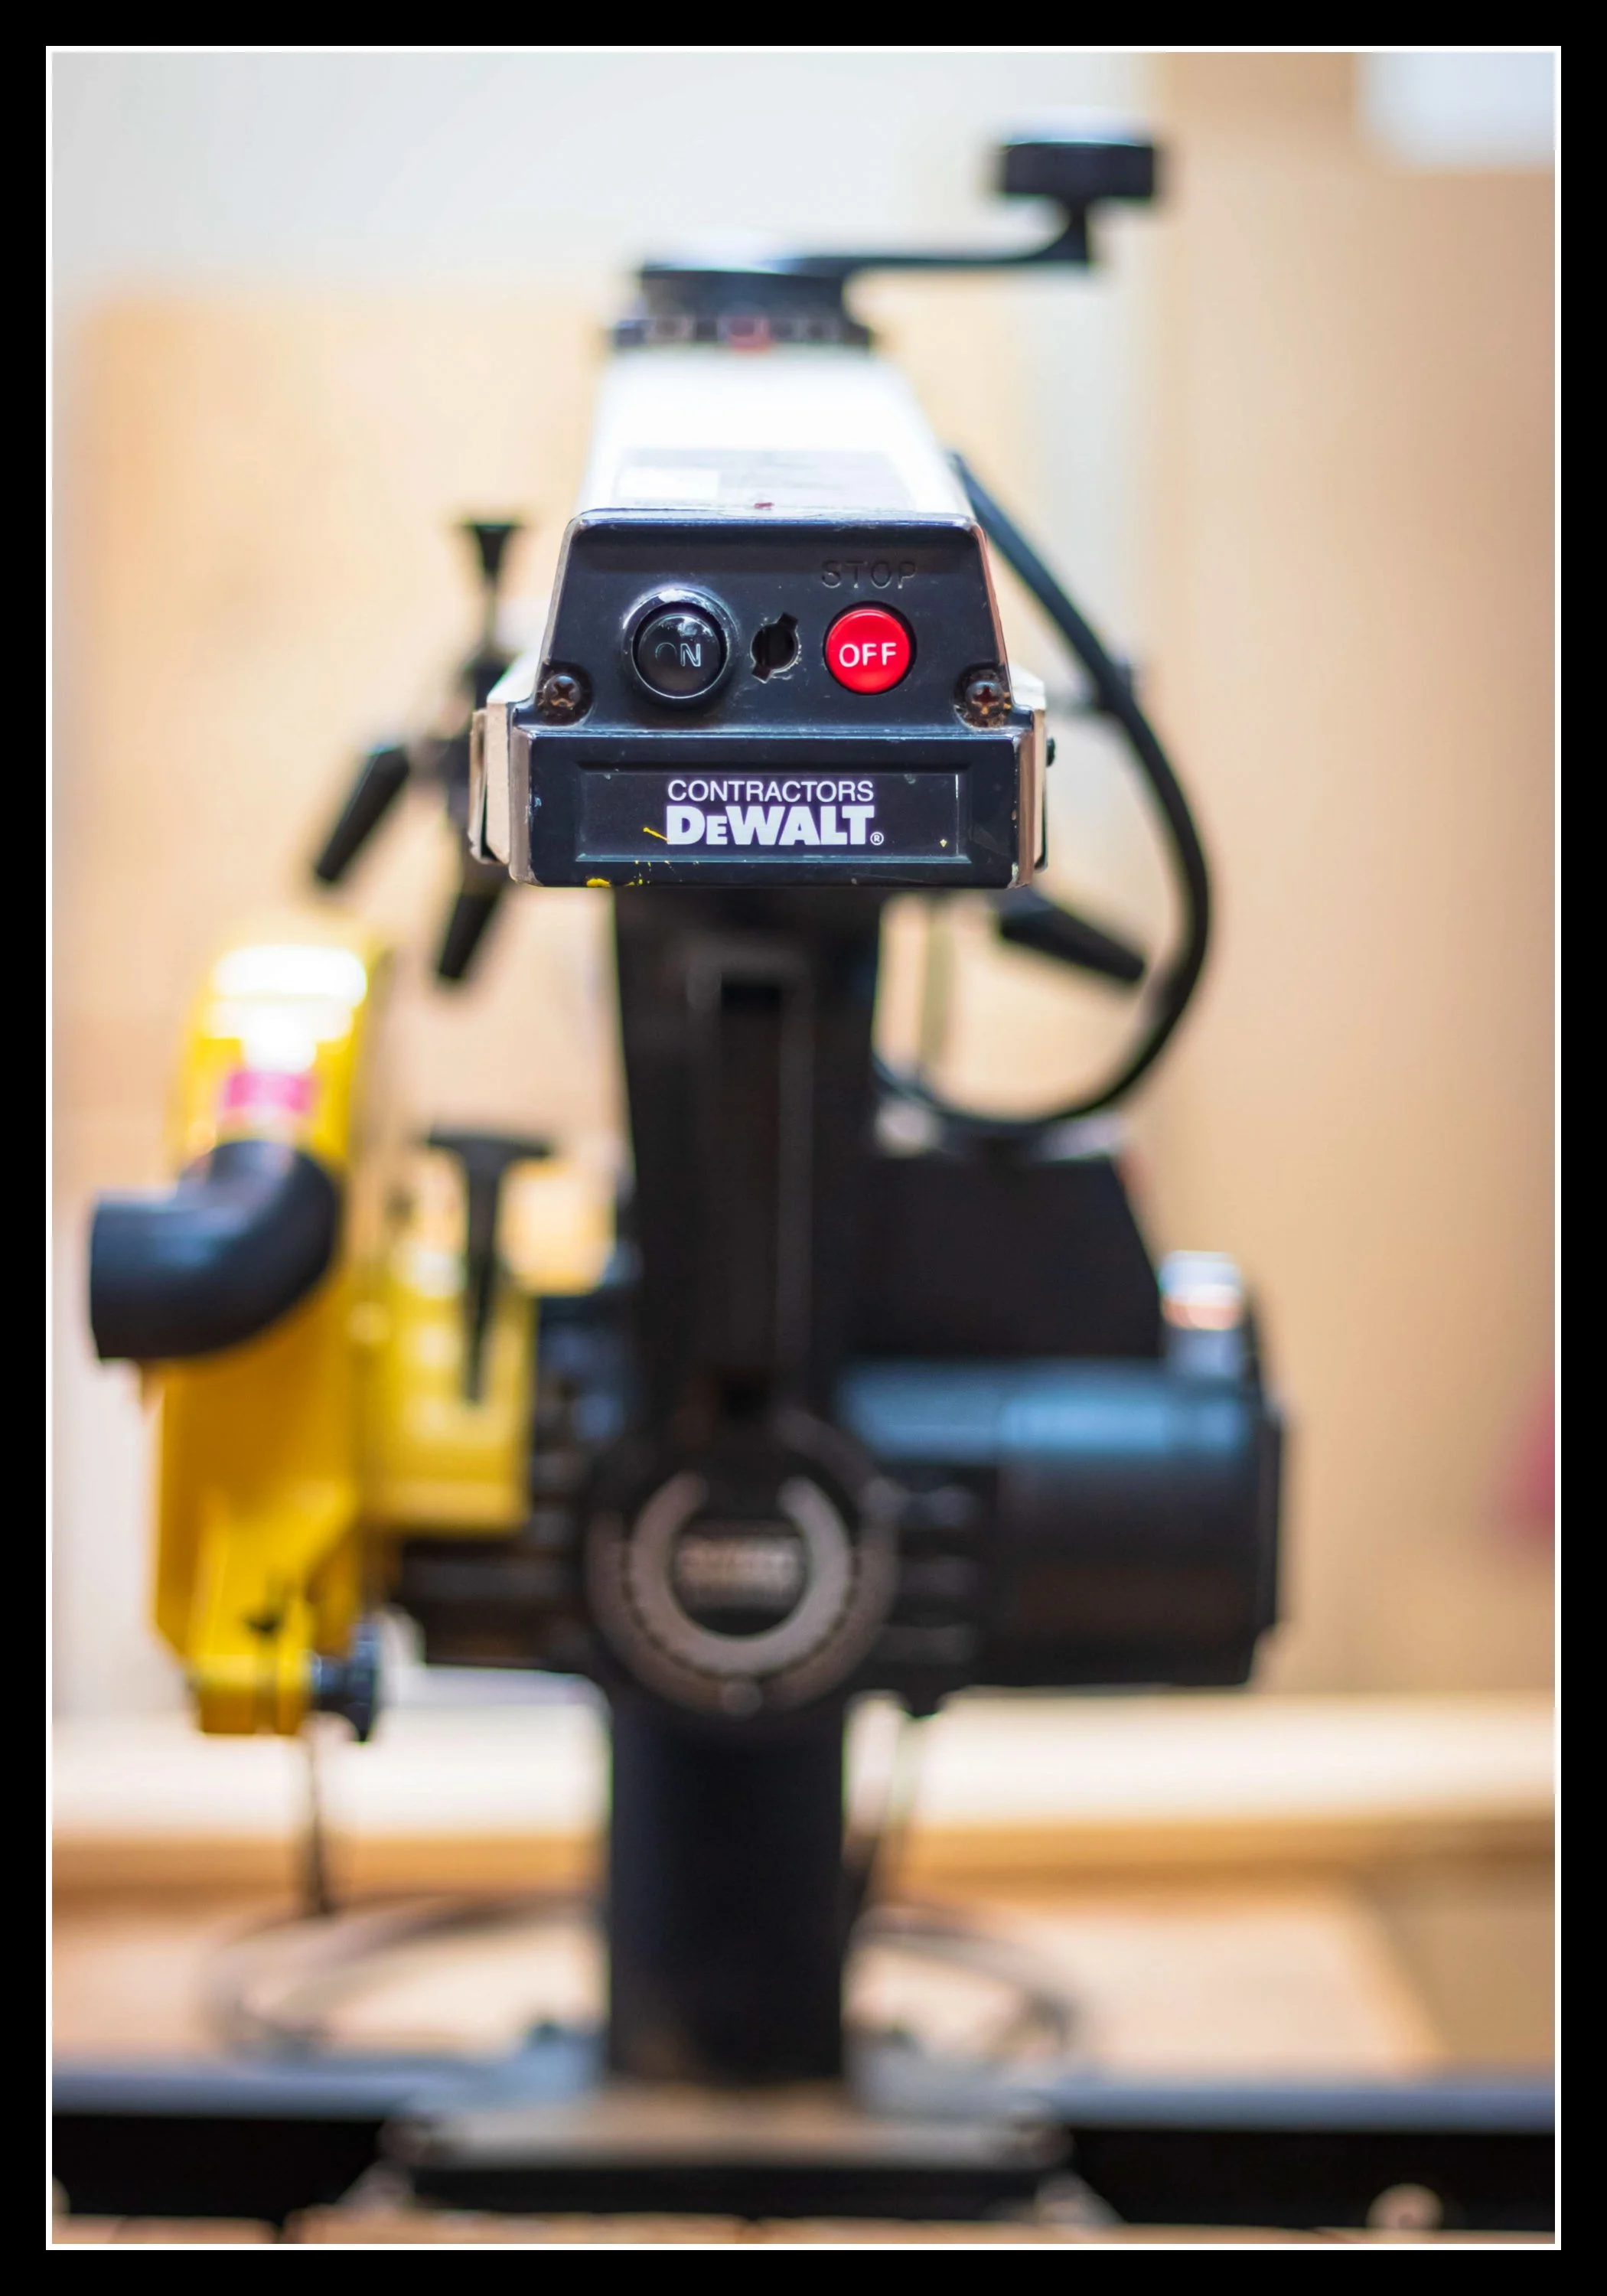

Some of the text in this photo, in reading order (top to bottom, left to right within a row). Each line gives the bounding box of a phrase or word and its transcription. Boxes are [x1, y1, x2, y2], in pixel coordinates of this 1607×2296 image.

[821, 561, 917, 589] STOP
[839, 643, 897, 667] OFF
[667, 779, 874, 802] CONTRACTORS
